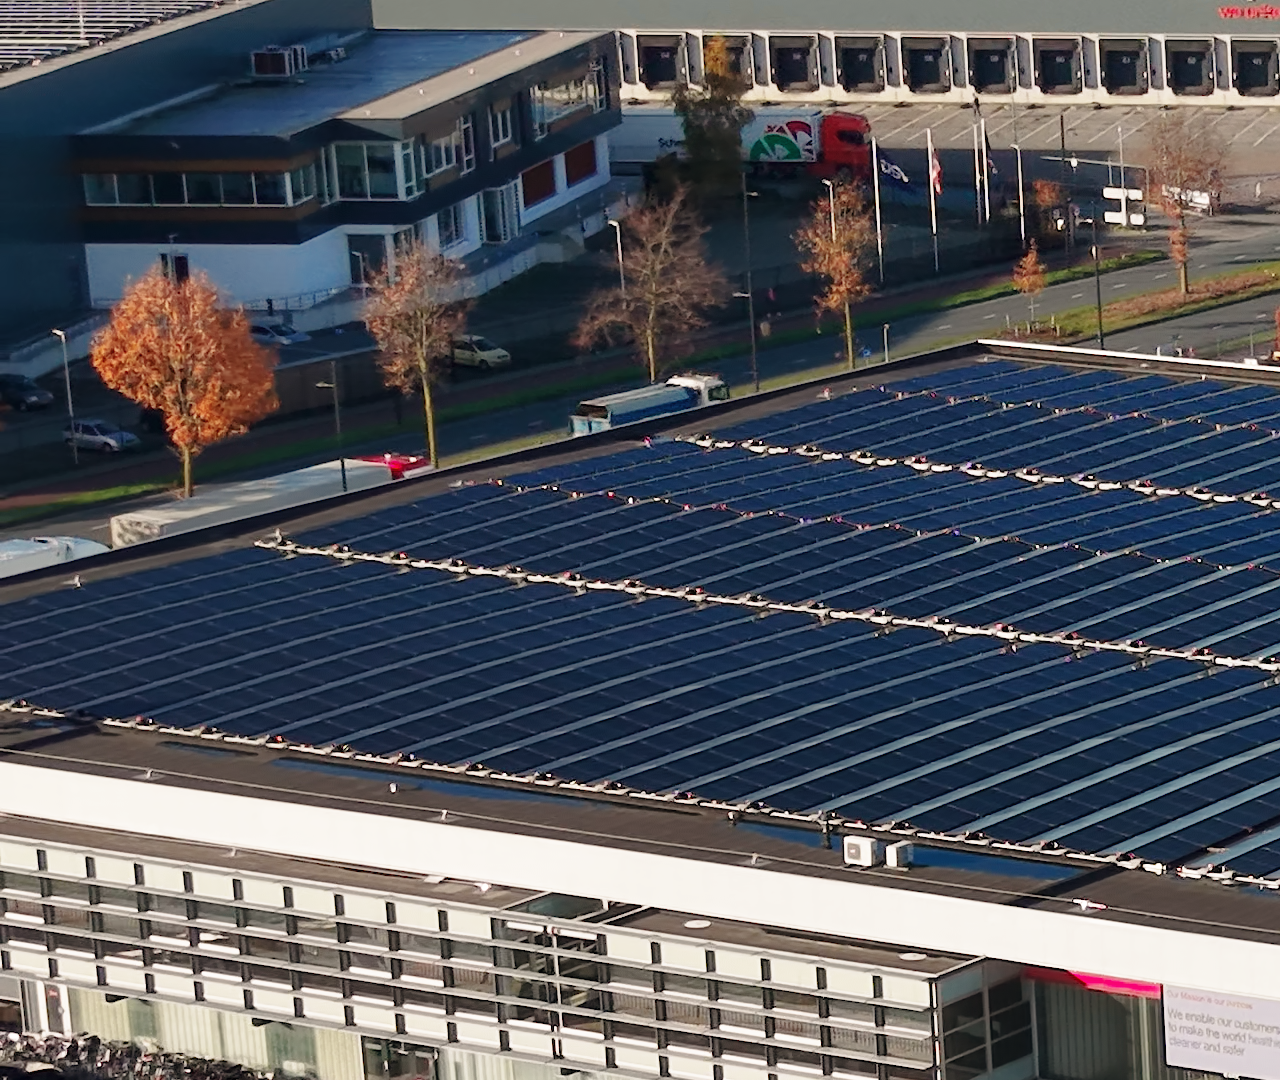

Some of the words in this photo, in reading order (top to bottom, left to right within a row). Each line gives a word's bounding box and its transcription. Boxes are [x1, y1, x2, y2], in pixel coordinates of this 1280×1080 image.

[1167, 1007, 1183, 1020] We
[1185, 1012, 1215, 1025] enable
[1217, 1017, 1232, 1028] our
[1234, 1020, 1280, 1035] customers
[1168, 1021, 1177, 1032] to
[1179, 1025, 1204, 1037] make
[1206, 1028, 1220, 1039] the
[1222, 1031, 1246, 1043] world
[1169, 1036, 1202, 1050] cleaner
[1203, 1042, 1220, 1053] and
[1222, 1044, 1245, 1056] safer
